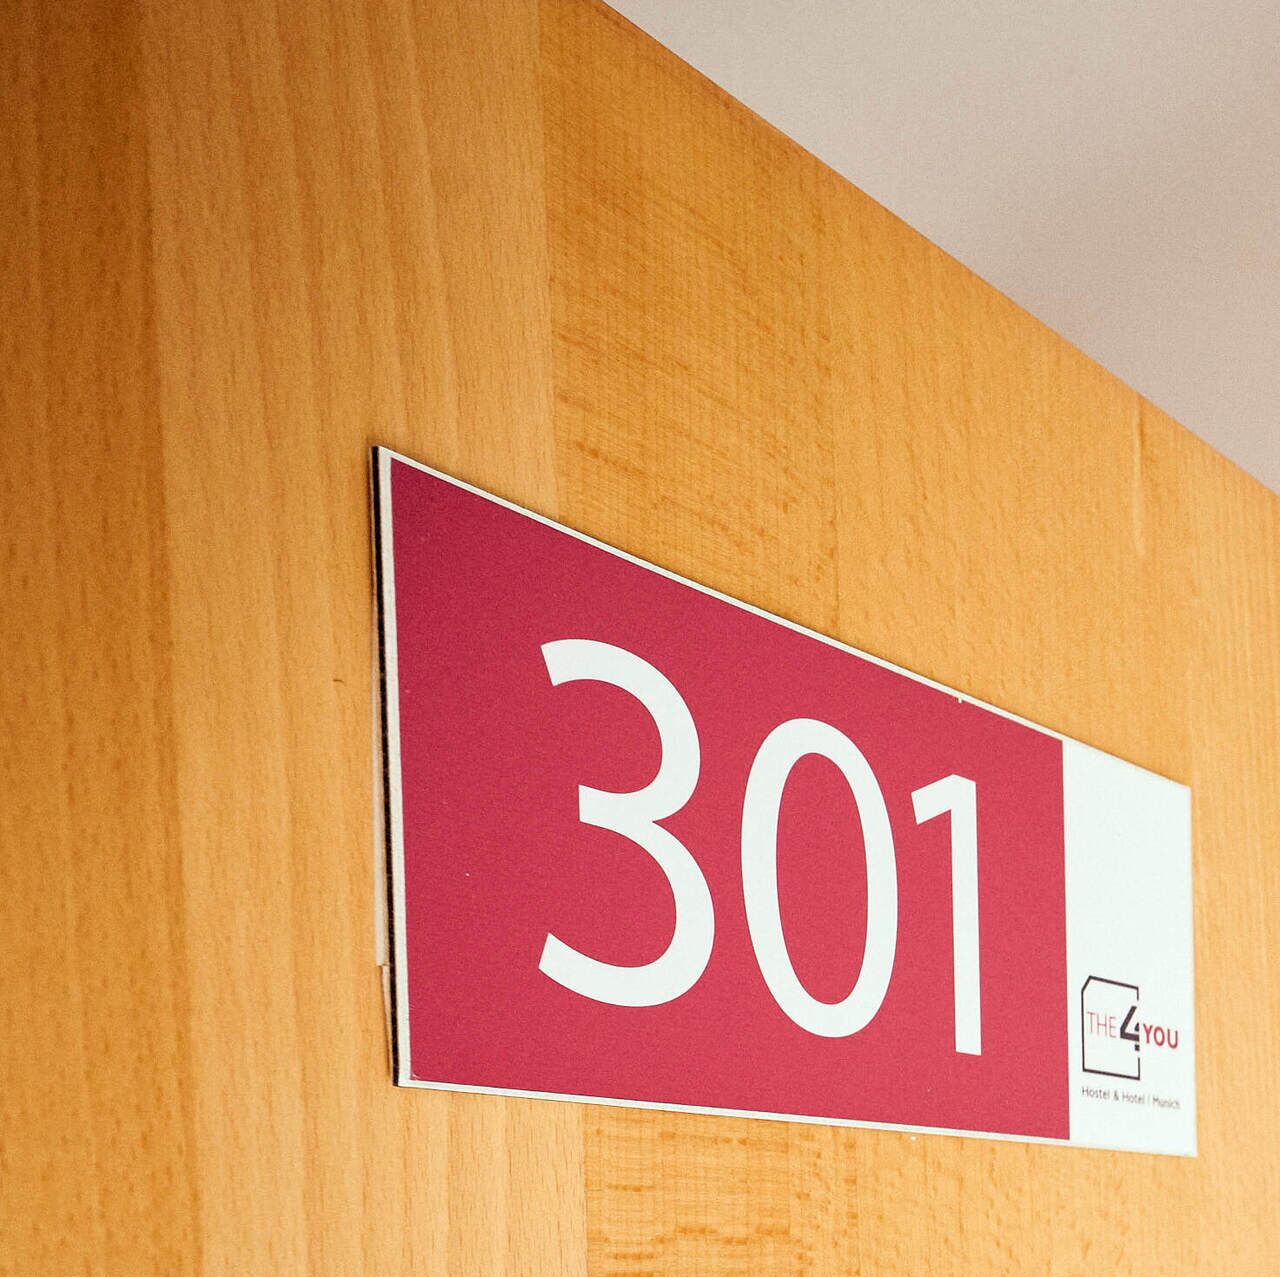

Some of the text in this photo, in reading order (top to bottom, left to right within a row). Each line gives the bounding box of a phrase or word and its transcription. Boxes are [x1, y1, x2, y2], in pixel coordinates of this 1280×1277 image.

[538, 638, 982, 1056] 301
[1087, 1005, 1179, 1052] THE 4 YOU
[1081, 1086, 1110, 1100] Hostel
[1113, 1090, 1120, 1101] &
[1122, 1092, 1145, 1105] Hotel
[1152, 1096, 1181, 1110] Munich
